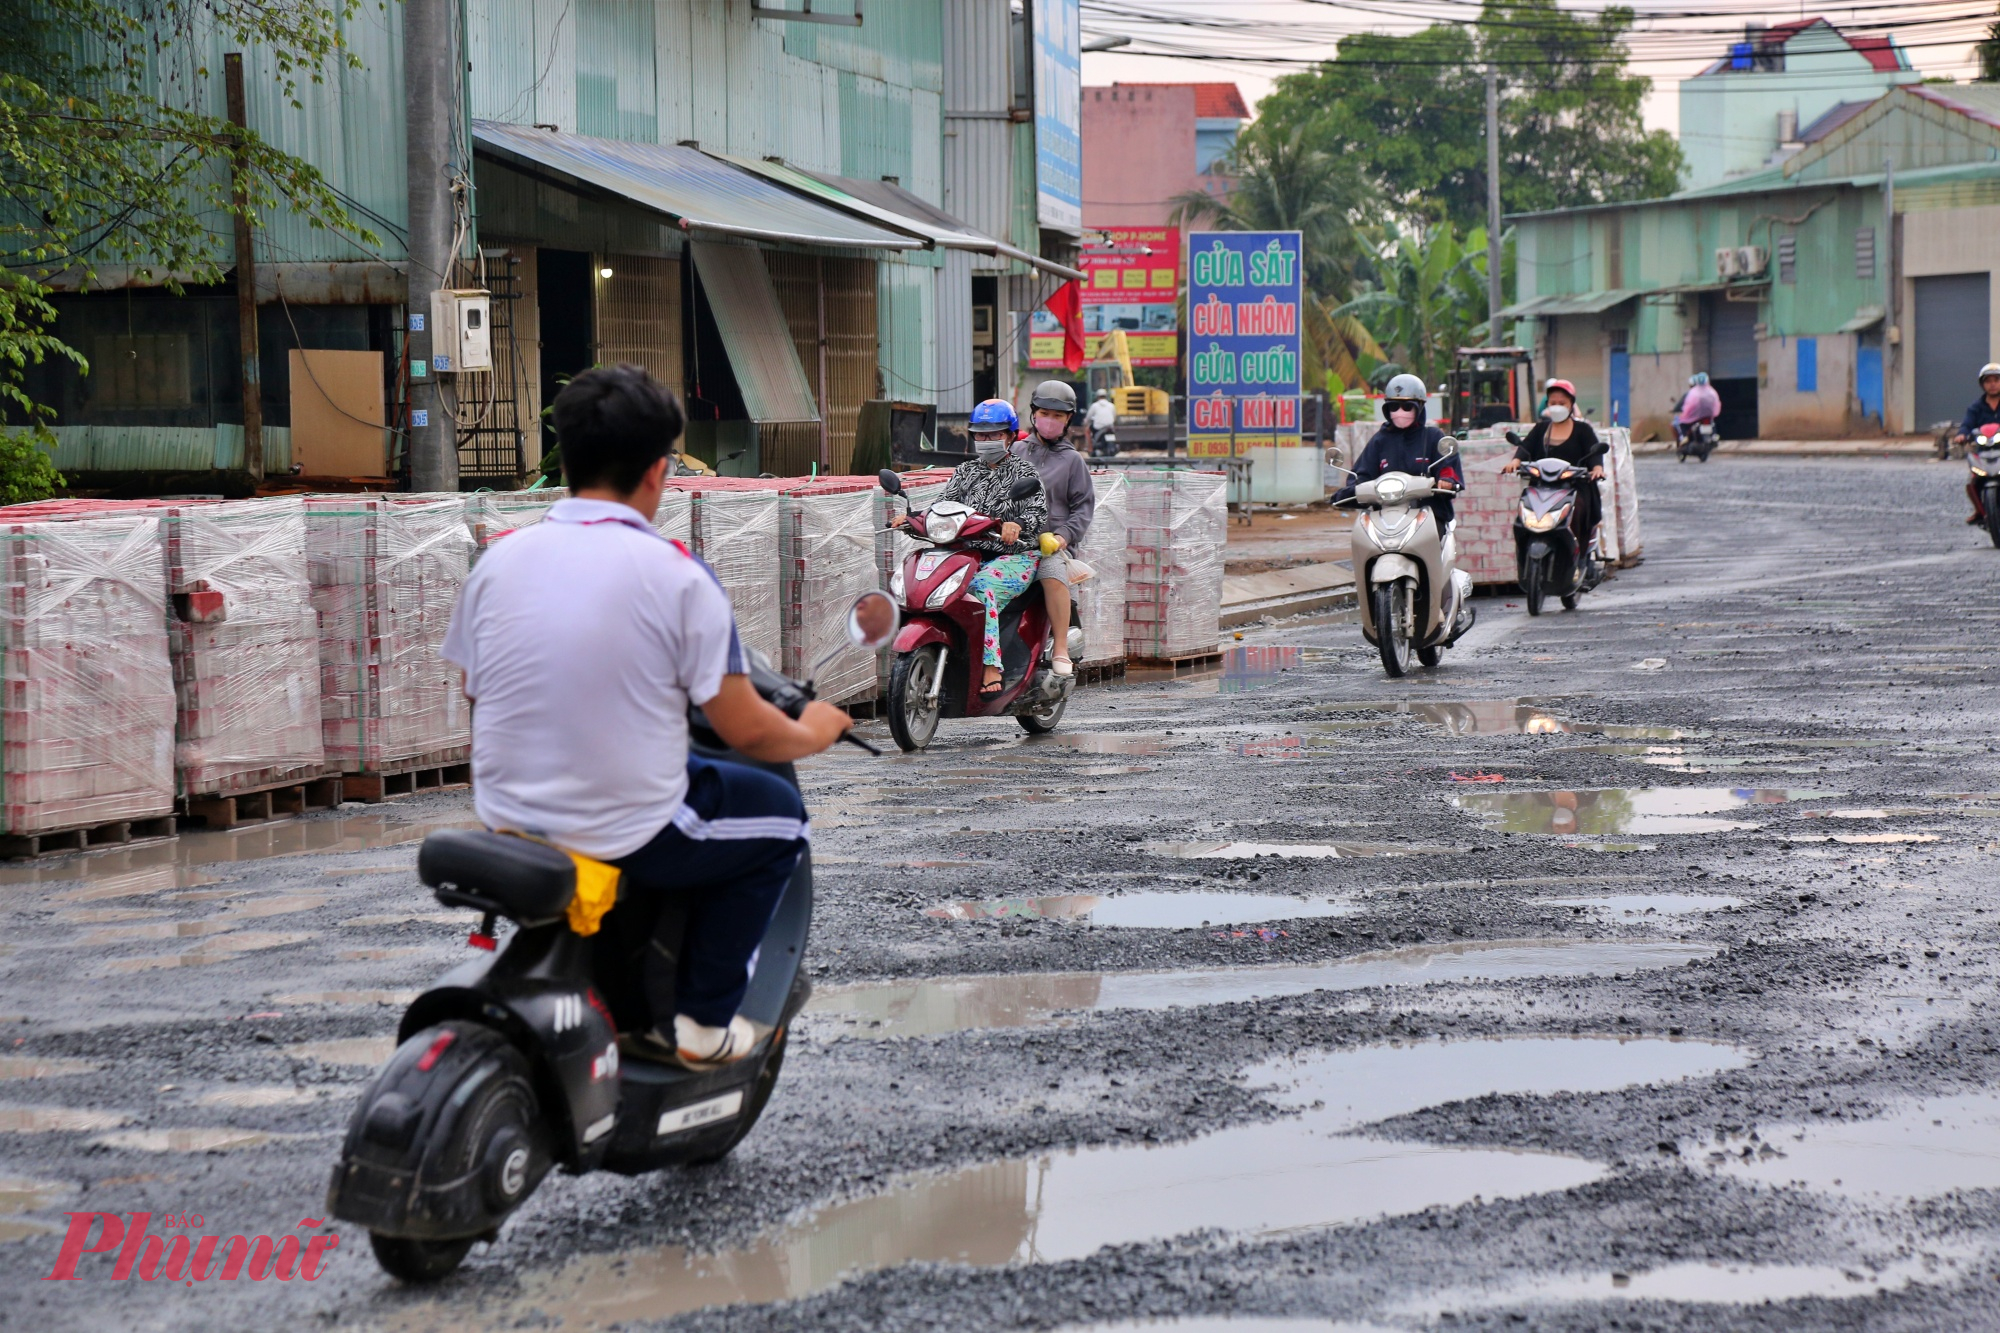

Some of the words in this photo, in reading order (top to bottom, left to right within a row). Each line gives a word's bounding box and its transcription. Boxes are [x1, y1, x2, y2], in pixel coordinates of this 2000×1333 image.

[1195, 240, 1245, 286] CỬA
[1250, 239, 1296, 286] SẮT
[1194, 293, 1233, 335] CỬA
[1238, 295, 1296, 335] NHÔM
[1195, 342, 1236, 384] CỬA
[1242, 344, 1296, 384] CUỐN
[1243, 391, 1295, 428] KÍNH
